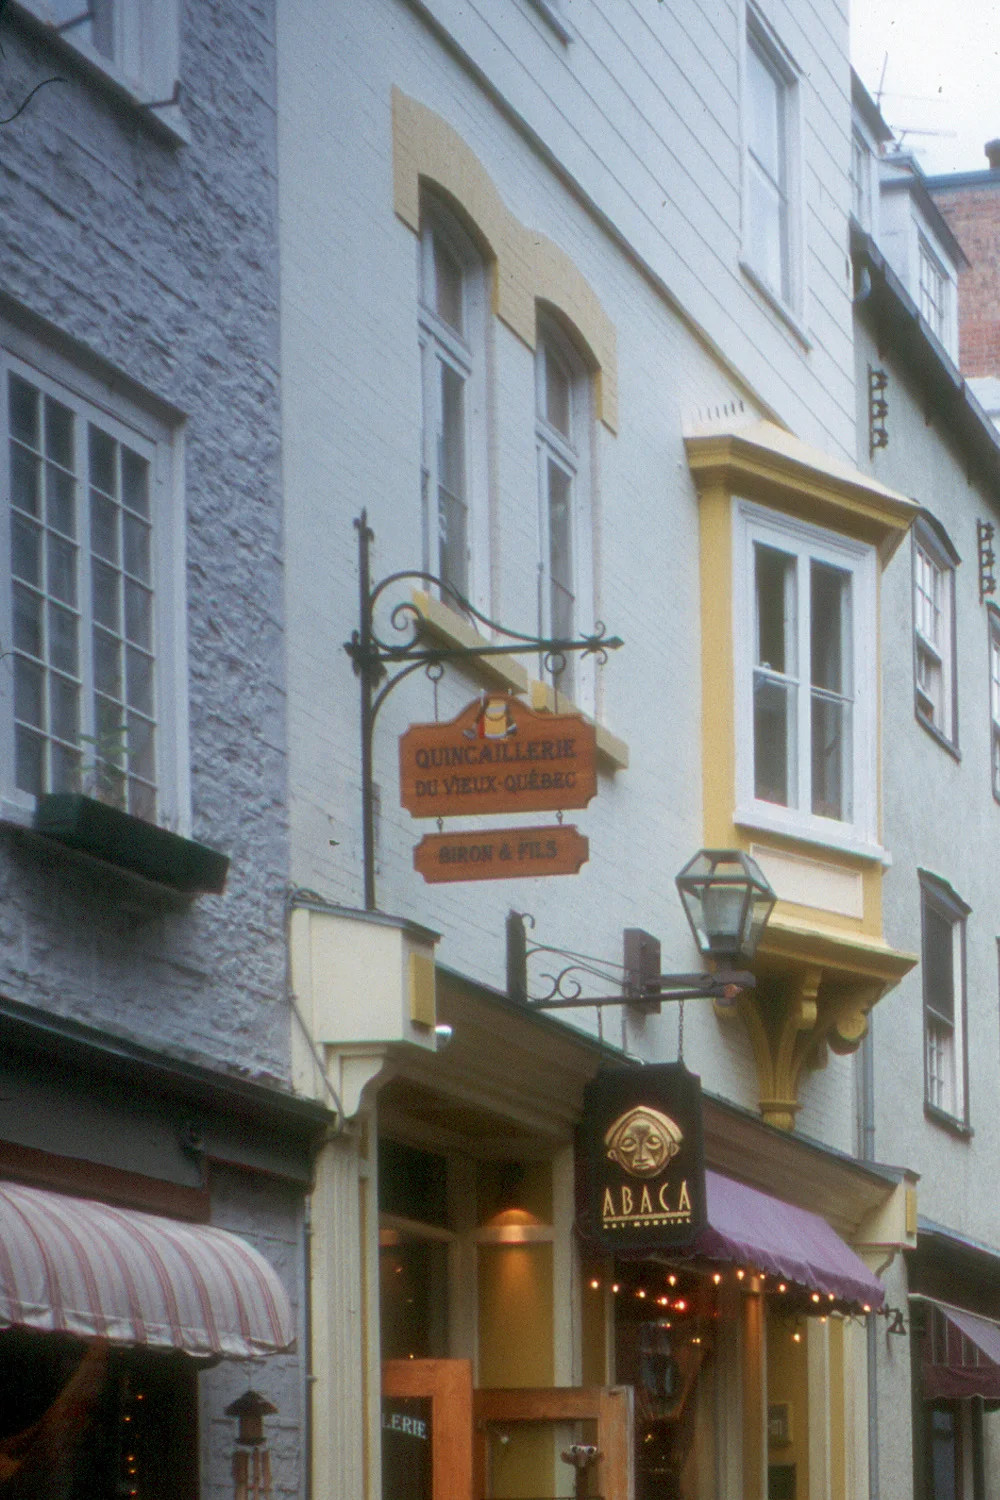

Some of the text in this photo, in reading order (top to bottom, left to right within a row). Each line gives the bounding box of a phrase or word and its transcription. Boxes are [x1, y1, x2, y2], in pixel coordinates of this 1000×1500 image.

[415, 738, 577, 769] QUINCAILLERIE
[415, 779, 438, 797] DU
[438, 840, 557, 864] BIRON & FILS
[603, 1180, 691, 1216] ABACA
